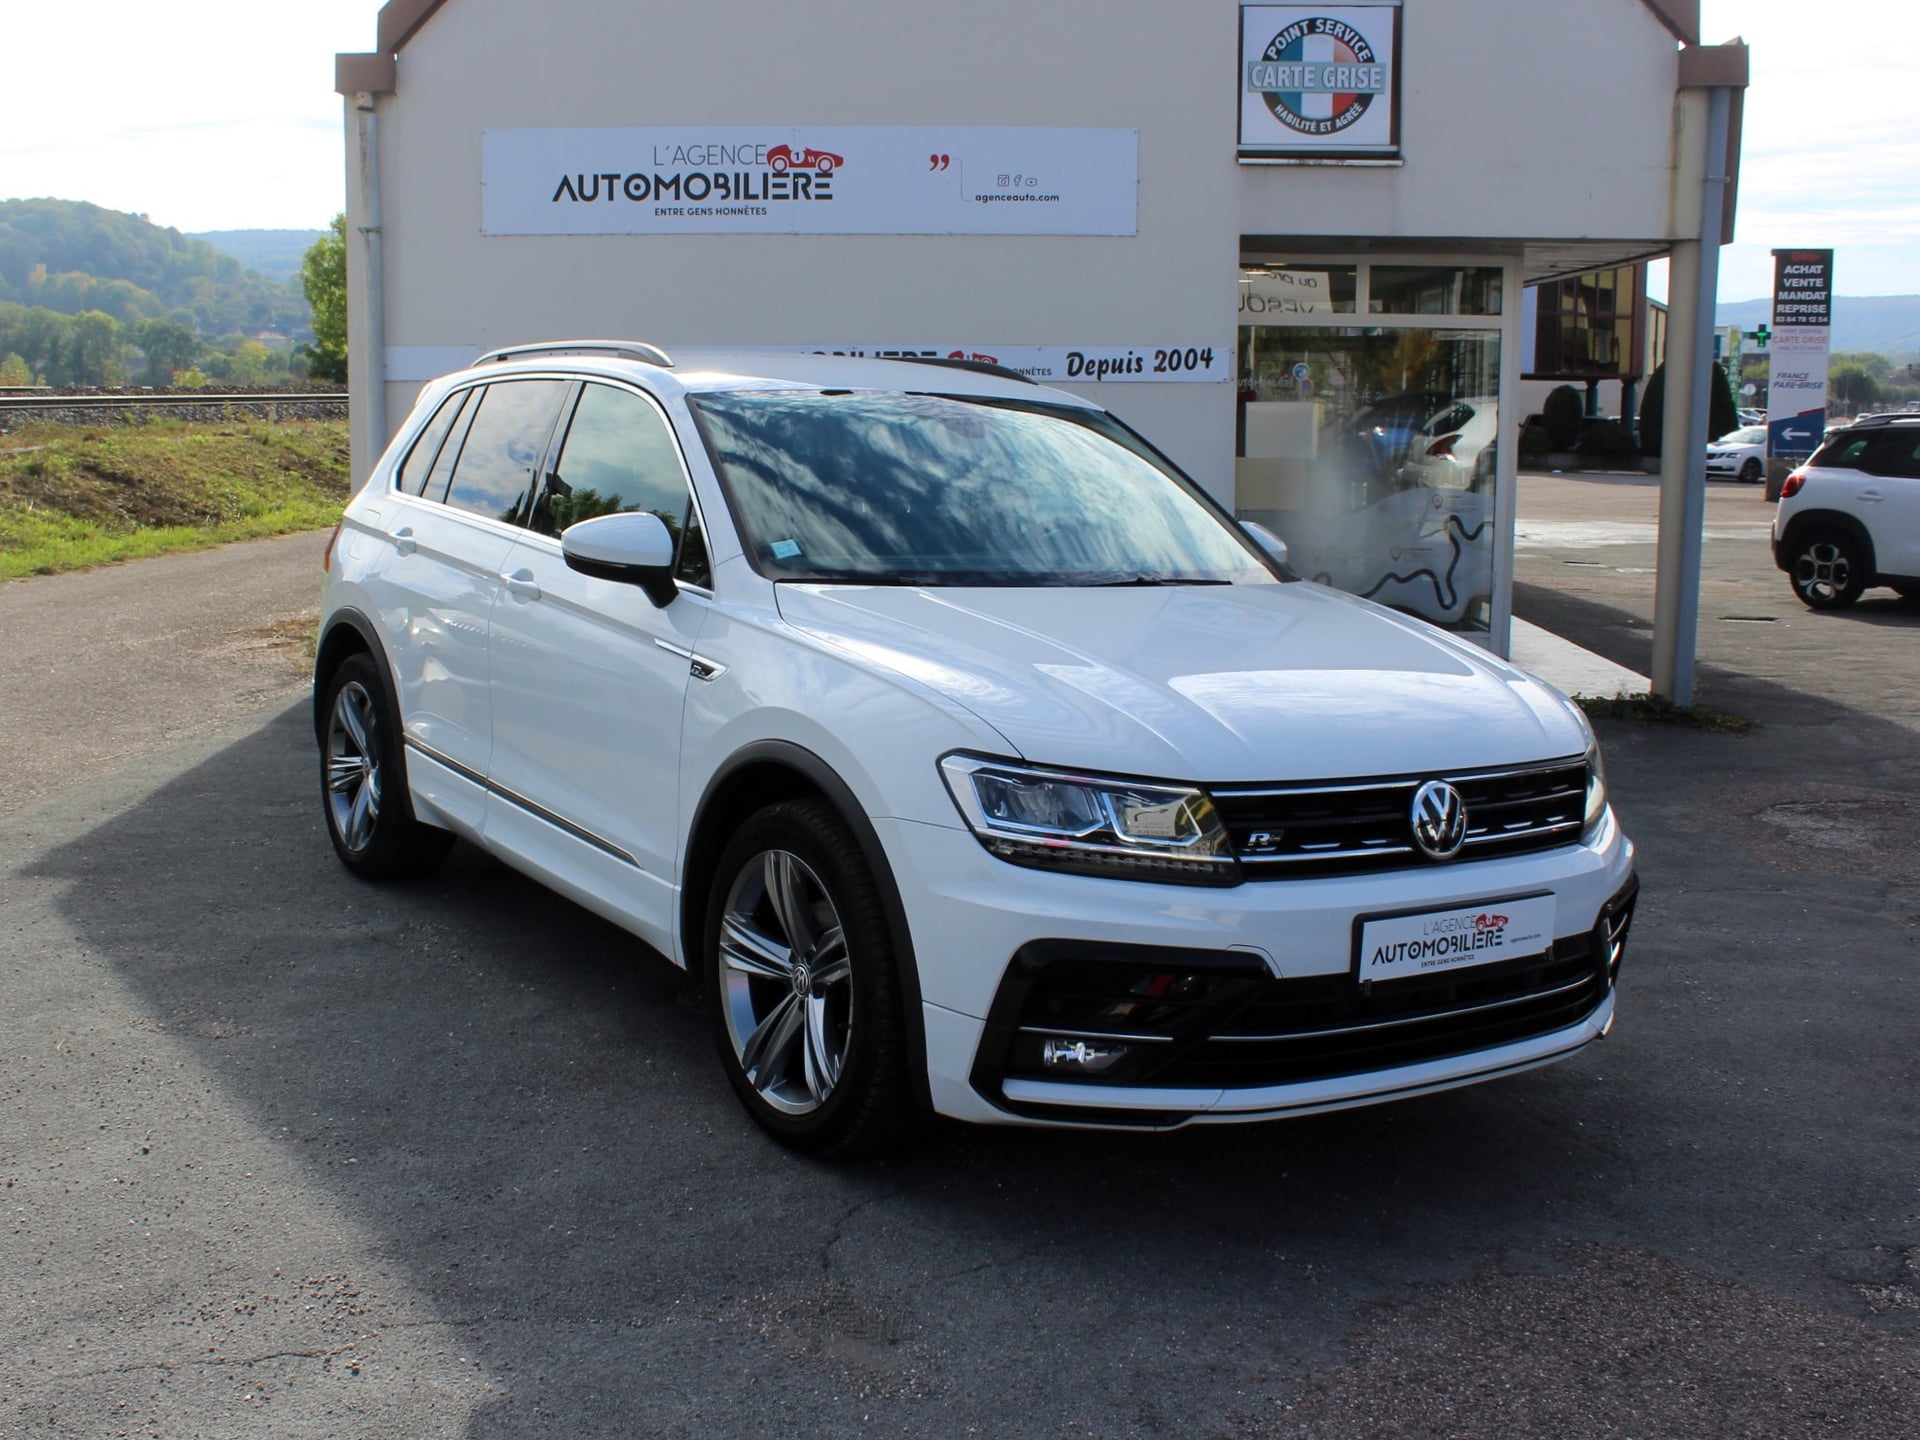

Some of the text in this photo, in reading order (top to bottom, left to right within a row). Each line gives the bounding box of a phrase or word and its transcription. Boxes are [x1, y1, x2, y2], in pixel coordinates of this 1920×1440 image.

[1267, 19, 1372, 62] POINT SERVICE
[1251, 66, 1382, 89] CARTE GRISE
[1274, 104, 1316, 132] HABILITÉ
[1320, 121, 1332, 132] ET
[653, 145, 767, 166] L'AGENCE
[975, 193, 1060, 203] agenceauto.com
[655, 205, 767, 216] ENTRE GENS HONNÊTES
[1784, 265, 1824, 274] ACHAT
[1783, 278, 1824, 287] VENTE
[1778, 291, 1828, 300] MANDAT
[1777, 304, 1827, 313] REPRISE
[1773, 335, 1828, 344] CARTE GRISE
[1066, 348, 1213, 382] Depuis 2004
[1013, 366, 1052, 377] NNÊTES
[1773, 381, 1824, 389] PARE-BRISE
[1423, 914, 1477, 936] L'AGENCE
